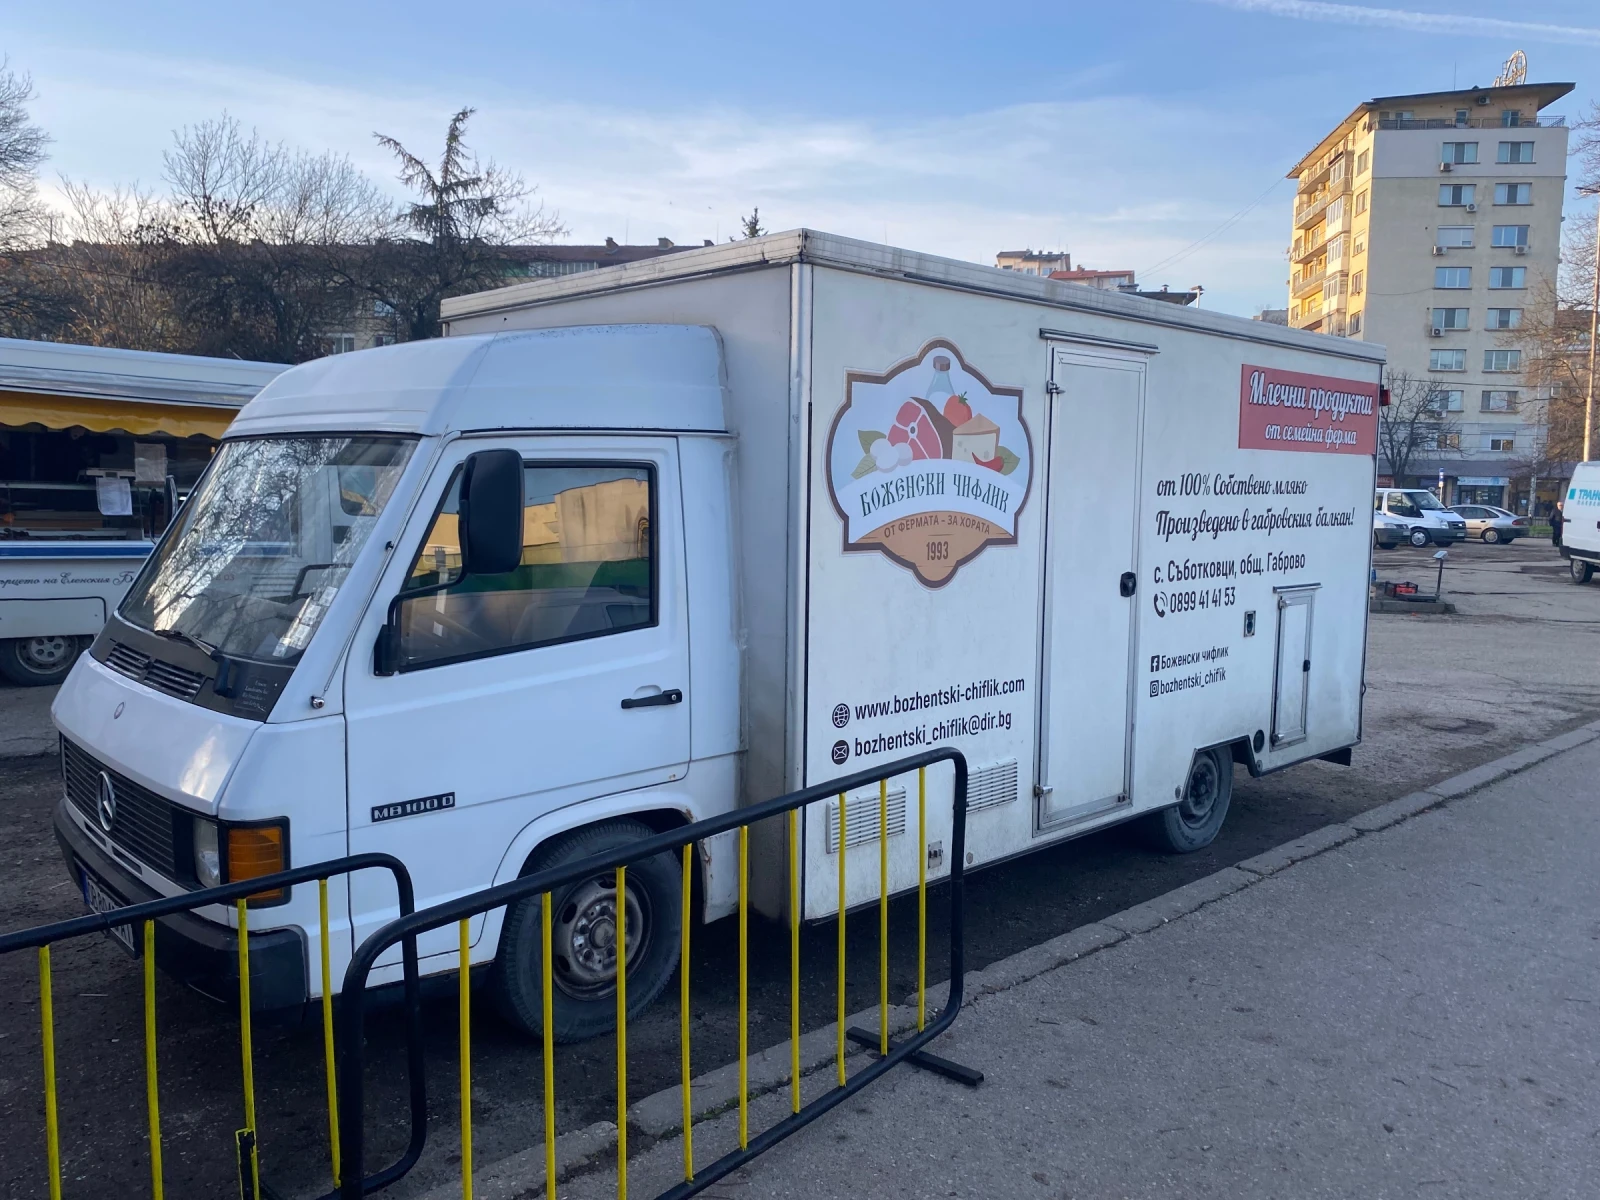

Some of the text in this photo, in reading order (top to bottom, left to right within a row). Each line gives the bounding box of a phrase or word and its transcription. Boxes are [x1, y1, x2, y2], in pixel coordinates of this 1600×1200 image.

[1249, 370, 1373, 421] Млечни продукти
[1265, 422, 1357, 449] от семейна ферма
[860, 472, 1010, 517] БОЖЕНСКИ ЧИФЛИК
[1156, 473, 1309, 497] от 100% Собствено мляко
[1579, 488, 1600, 501] ТРАН
[884, 524, 896, 538] ОТ
[898, 515, 939, 532] ФЕРМАТА
[947, 515, 958, 526] ЗА
[960, 516, 990, 535] ХОРАТА
[1155, 506, 1356, 542] Произведено в габровския балкан!
[926, 541, 949, 561] 1993
[1154, 550, 1306, 584] с. Съботковци, общ. Габрово
[1170, 586, 1236, 613] 0899 41 41 53
[1161, 646, 1229, 670] Боженски чифлик
[855, 678, 1025, 720] www.bozhentski-chiflik.com
[854, 710, 1012, 757] bozhentski_chiflik@dir.bg
[374, 795, 454, 819] MB 100 D
